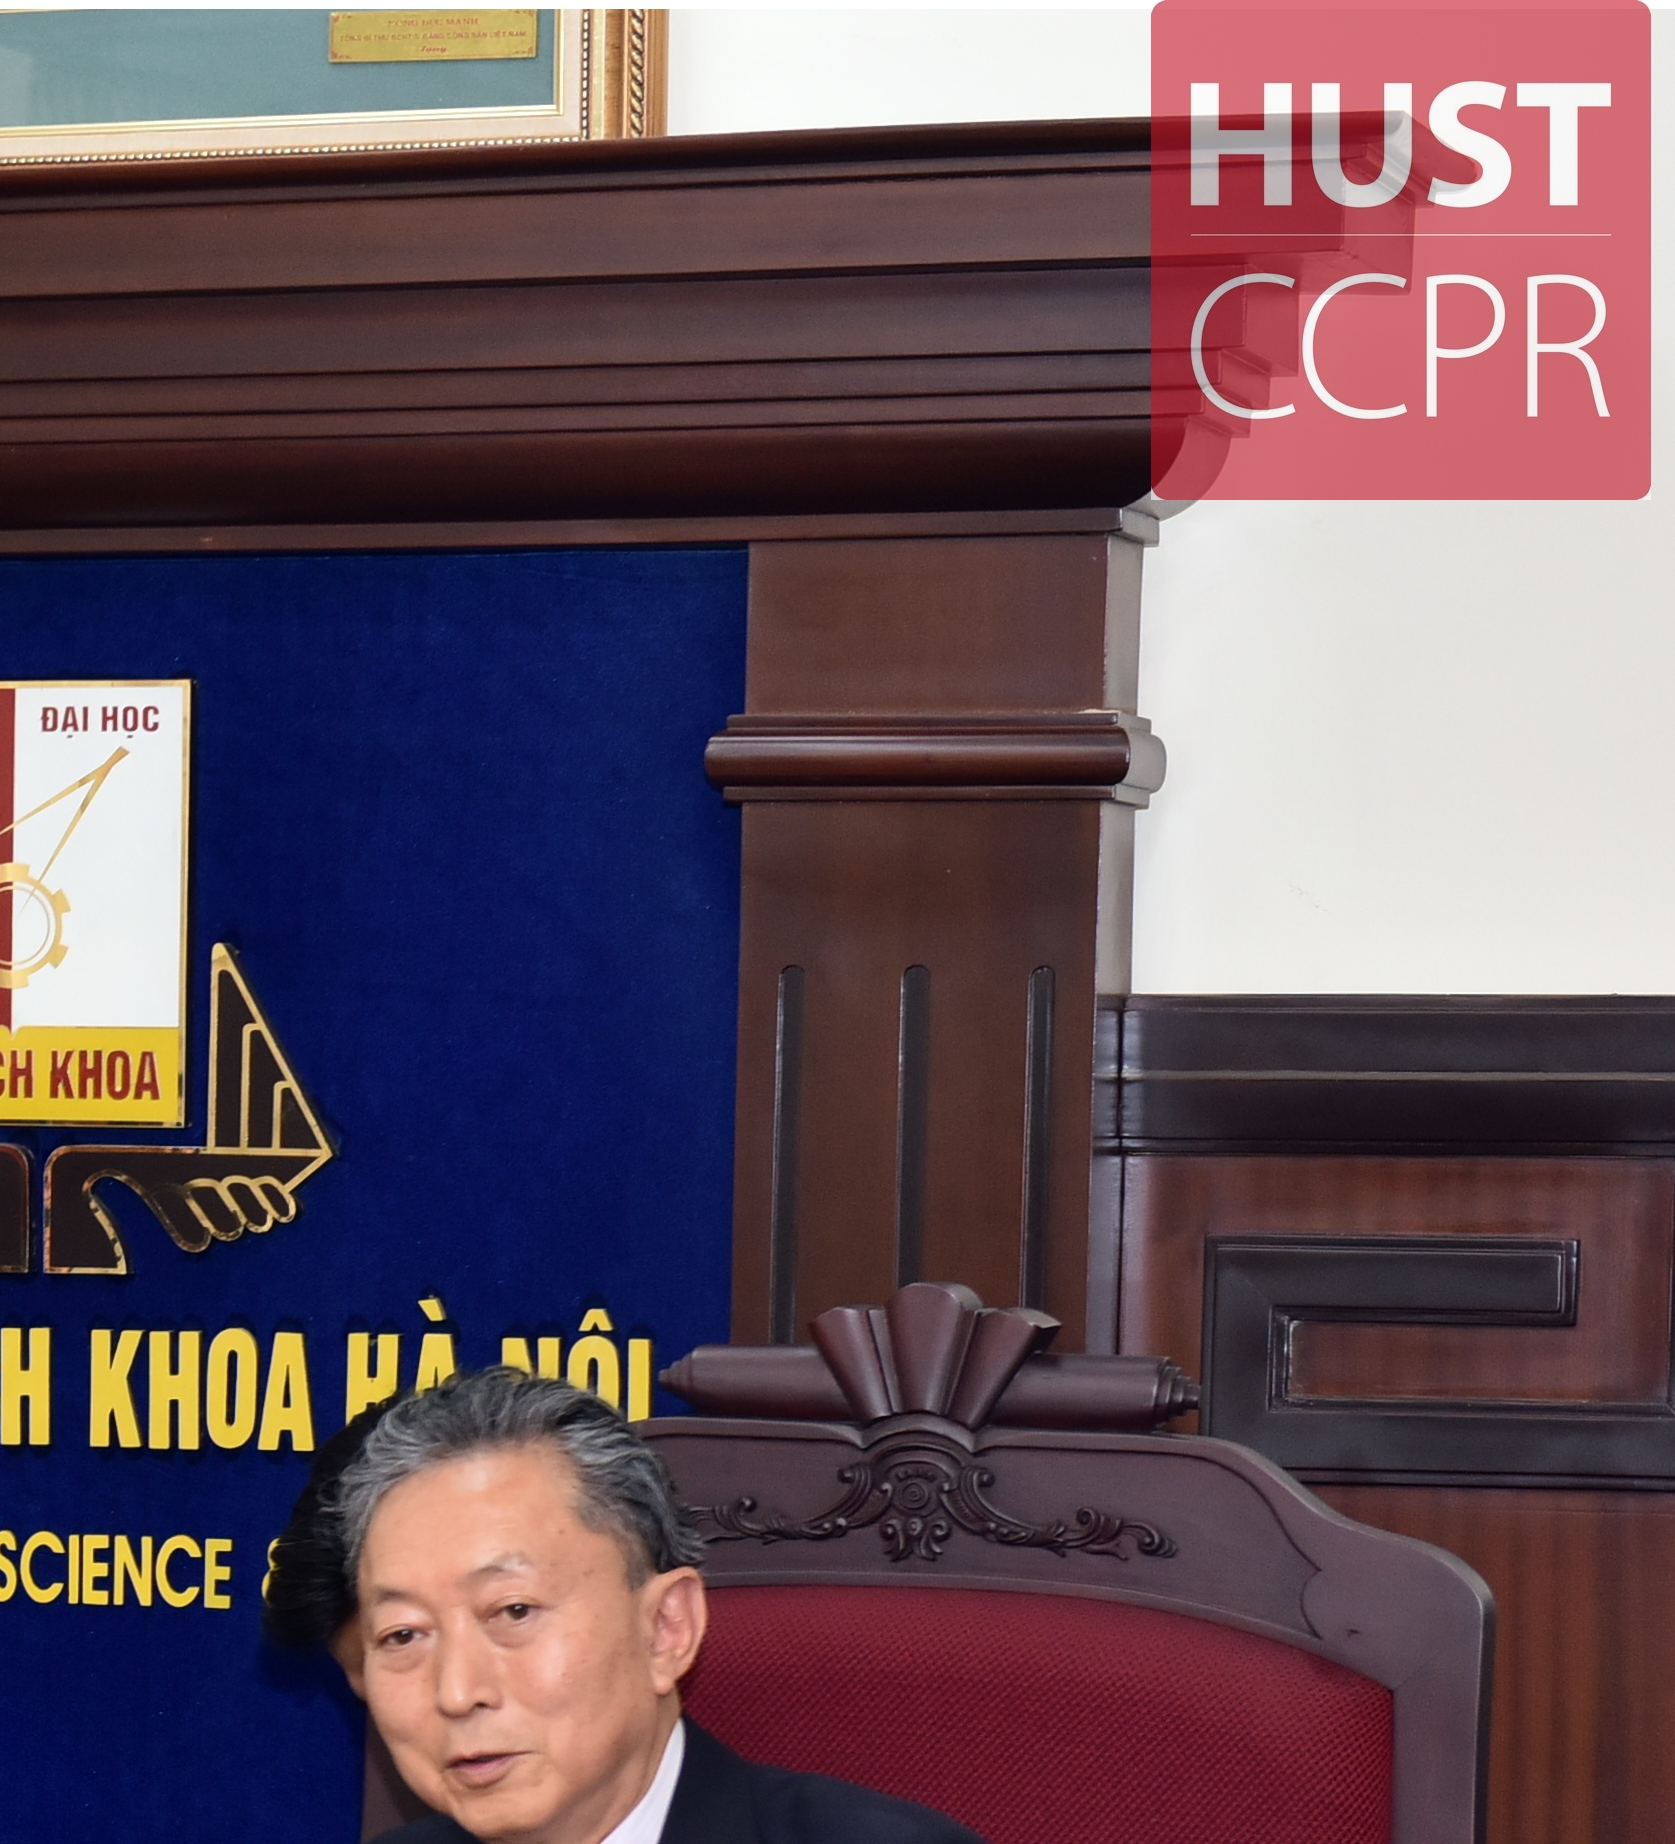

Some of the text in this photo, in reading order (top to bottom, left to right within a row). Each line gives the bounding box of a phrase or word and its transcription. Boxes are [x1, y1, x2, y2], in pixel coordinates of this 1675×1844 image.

[40, 706, 160, 739] ĐẠI HỌC
[49, 1049, 161, 1101] KHOA
[89, 1327, 315, 1452] KHOA
